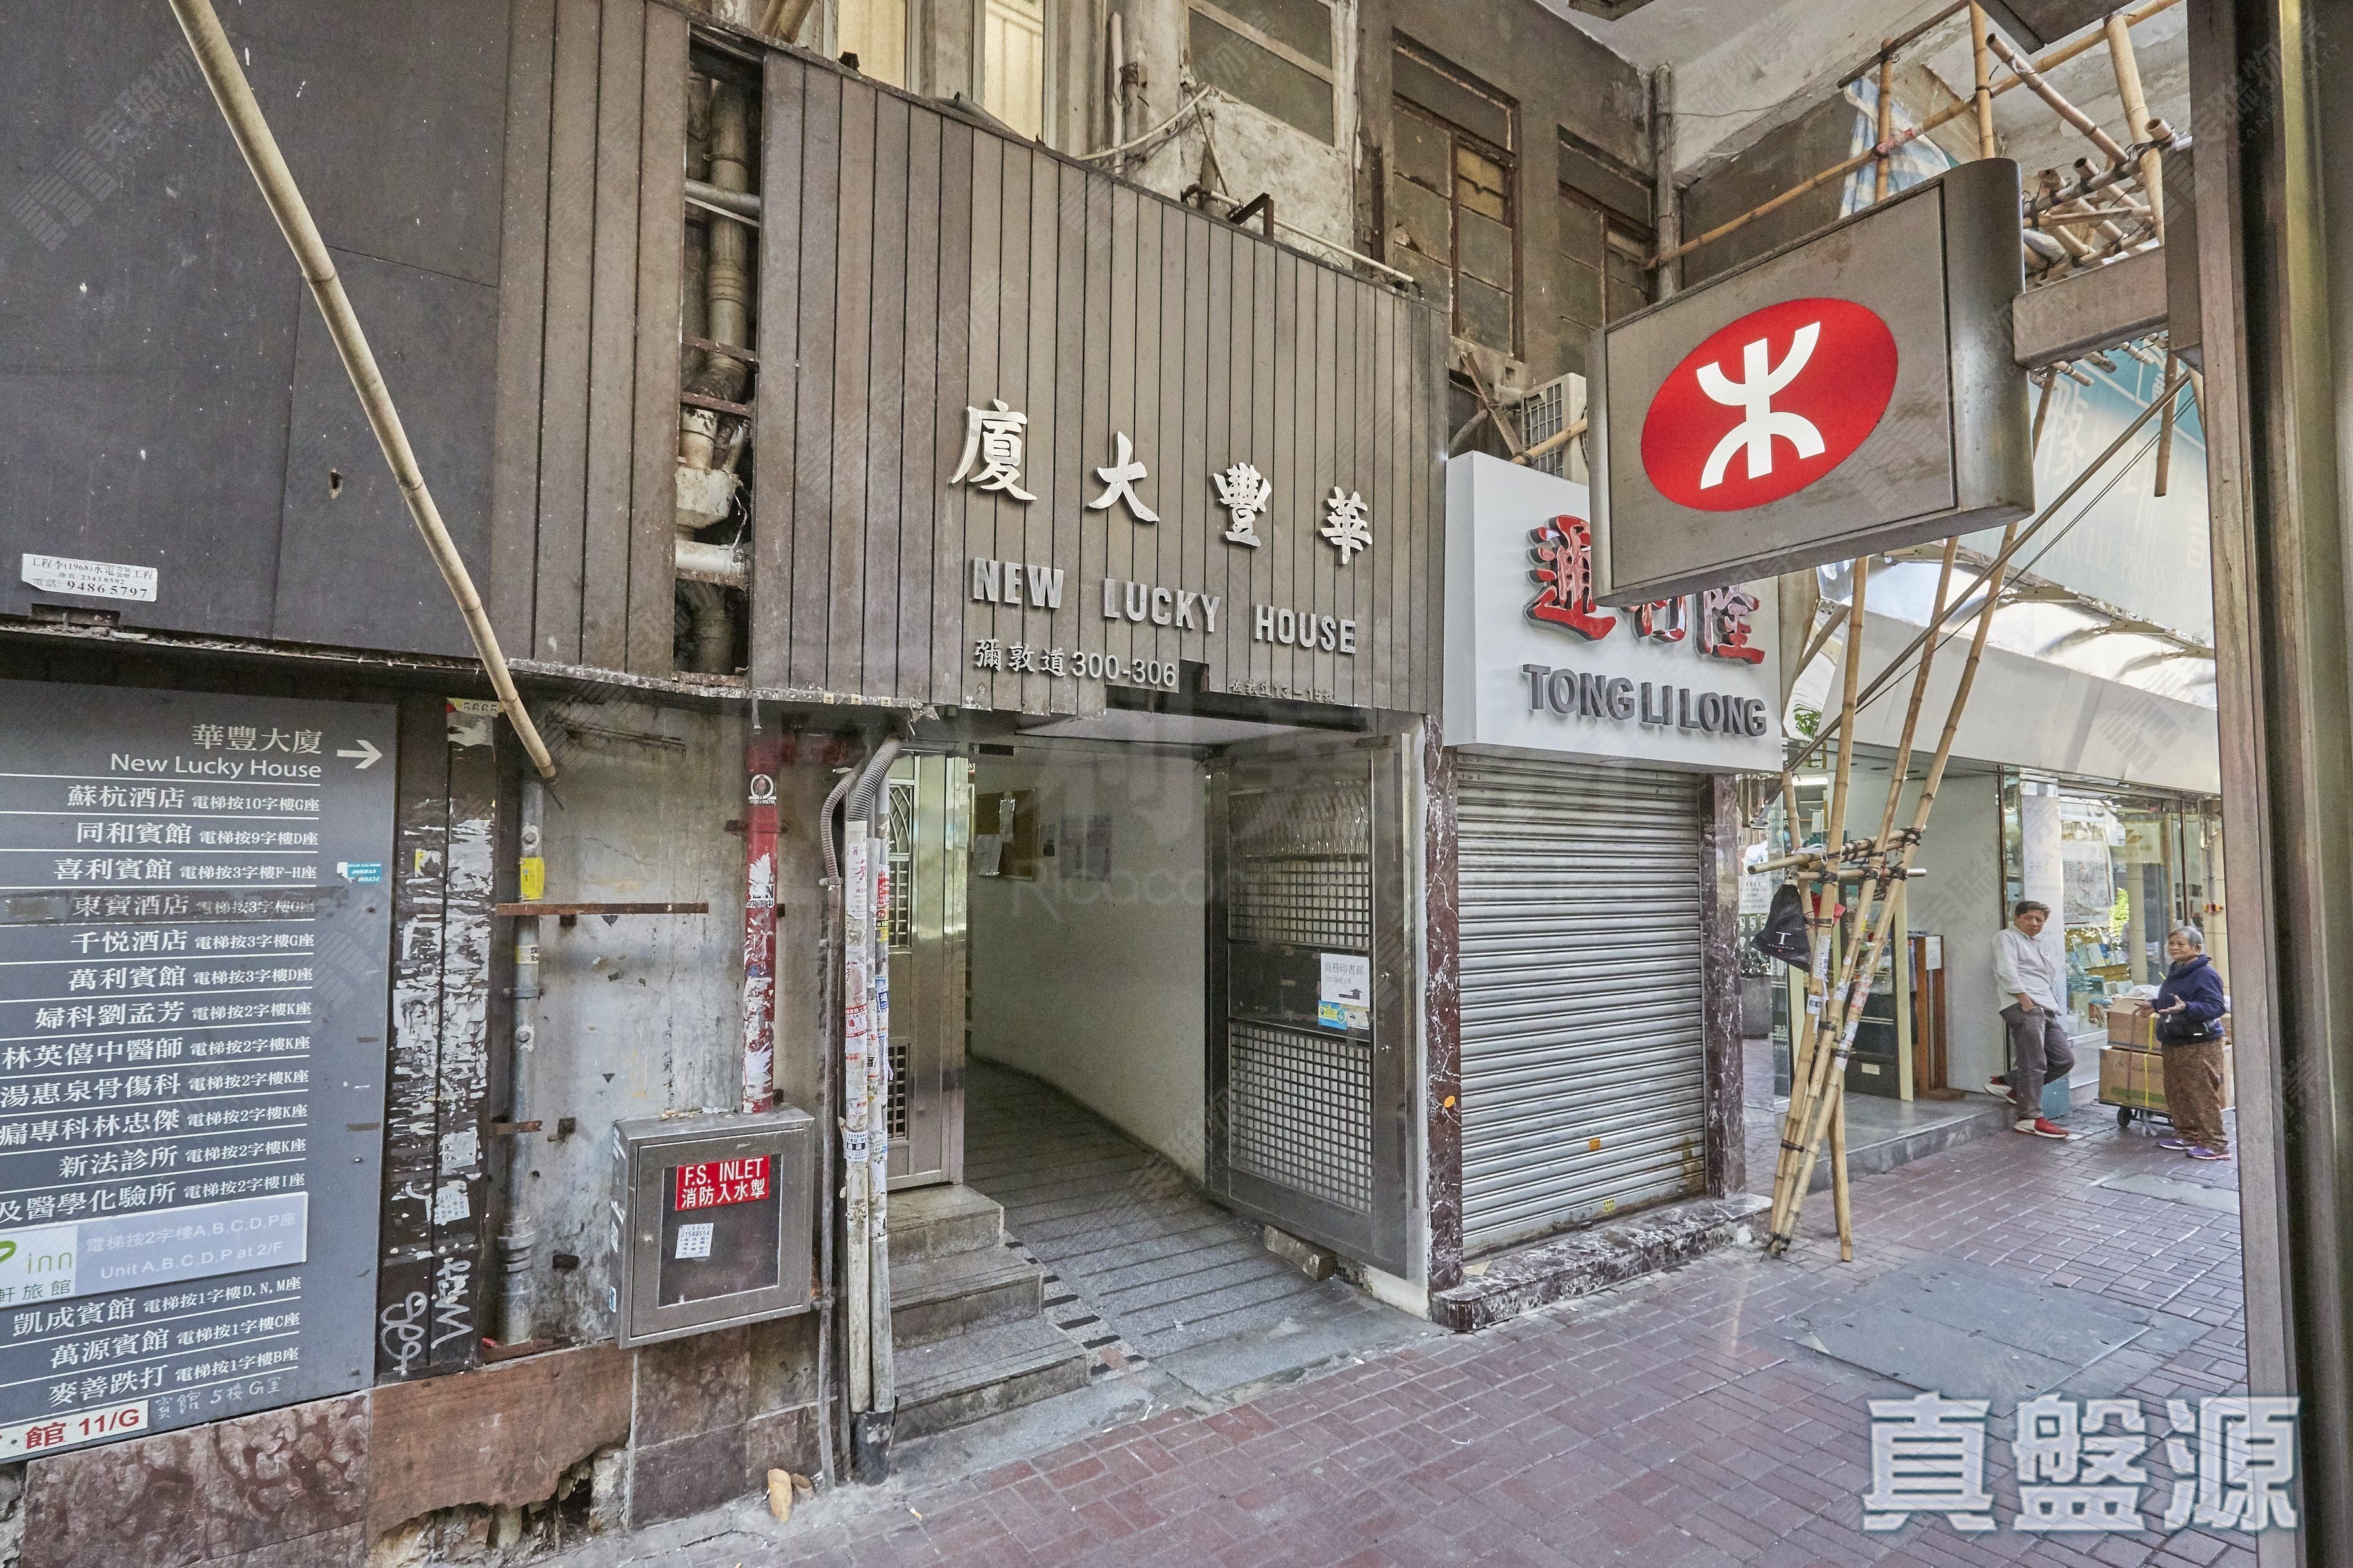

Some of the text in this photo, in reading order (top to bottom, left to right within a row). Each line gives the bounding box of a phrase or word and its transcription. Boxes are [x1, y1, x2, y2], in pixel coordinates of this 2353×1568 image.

[67, 580, 105, 594] 9486
[110, 585, 148, 598] 5797
[972, 557, 1357, 655] NEW LUCKY HOUSE
[1523, 664, 1635, 720] TONG
[1680, 688, 1767, 737] LONG
[192, 724, 322, 754] 華豐大廈
[111, 753, 322, 779] New Lucky House
[192, 795, 320, 811] 電梯按10字樓G座
[77, 822, 318, 846] 同和賓館 電梯按9字樓D座
[54, 858, 316, 881] 喜利賓館 電梯按3字樓F-H座
[194, 933, 314, 950] 電梯按3字樓G座
[68, 966, 313, 992] 萬利賓館 電梯按3字樓D座
[35, 1001, 312, 1030] 婦科劉孟芳 電梯按2字樓K座
[190, 1036, 310, 1057] 電梯按2字樓K座
[189, 1069, 309, 1092] 電梯按2字樓K座
[187, 1104, 308, 1128] 電梯按2字樓K座
[59, 1138, 306, 1178] 新法診所 電梯按2字樓K座
[684, 1157, 764, 1186] F.S. INLET
[681, 1178, 765, 1208] 消防入水掣
[101, 1263, 138, 1279] Unit
[237, 1247, 252, 1259] at
[256, 1241, 283, 1256] 2/F
[12, 1298, 136, 1337] 凱成賓館
[50, 1312, 300, 1369] 萬源賓館 電梯按1字樓C座
[175, 1347, 299, 1383] 電梯按1字樓B座
[79, 1408, 139, 1436] 11/G
